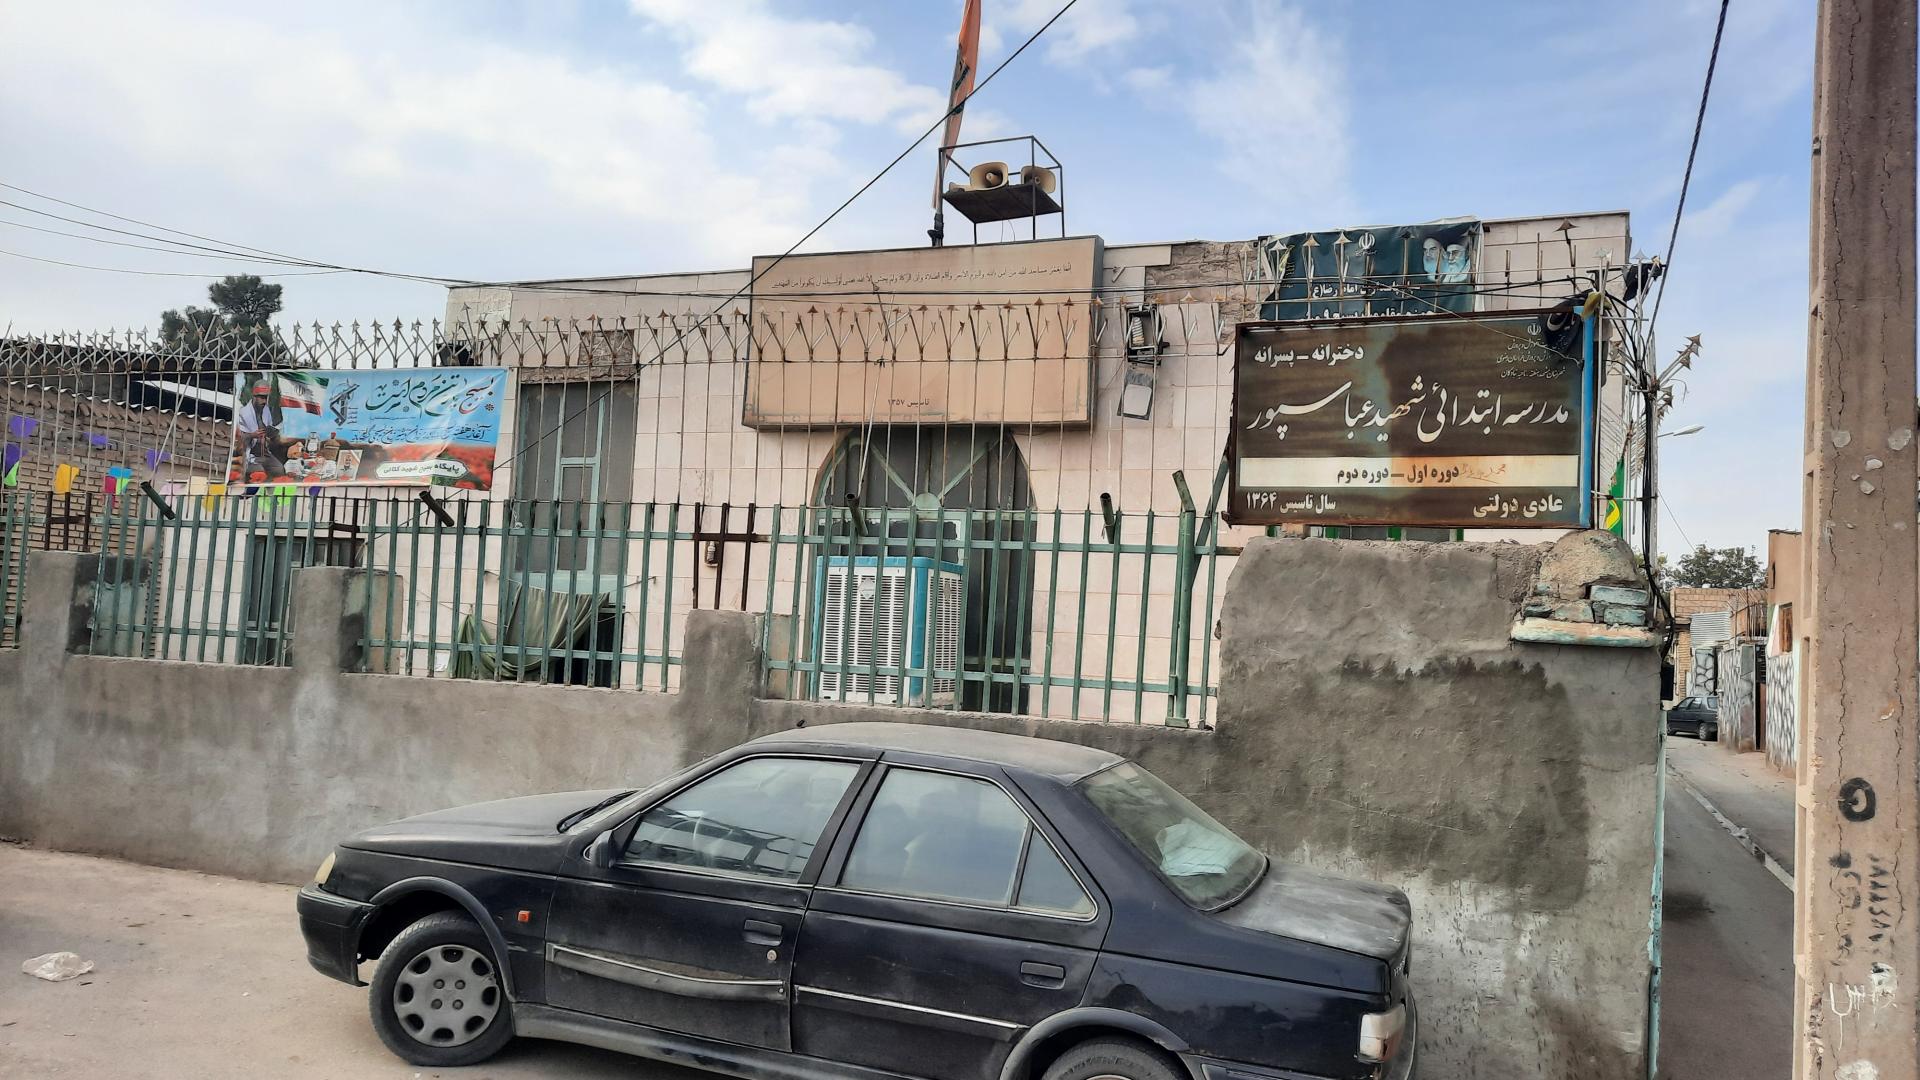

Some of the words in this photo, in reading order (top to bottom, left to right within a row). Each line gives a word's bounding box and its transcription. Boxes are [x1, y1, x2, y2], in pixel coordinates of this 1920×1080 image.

[1254, 345, 1295, 368] پسرانه
[1312, 343, 1365, 366] دخترانه
[408, 375, 442, 419] مردم
[1362, 375, 1427, 442] شهید
[1501, 401, 1569, 427] مدرسه
[433, 463, 460, 475] پایگاه
[1337, 467, 1359, 484] دوم
[1361, 466, 1389, 483] دوره
[1407, 463, 1428, 483] اول
[1431, 465, 1459, 484] دوره
[1246, 491, 1278, 511] ۱۳۶۴
[1280, 493, 1314, 514] تاسیس
[1315, 493, 1336, 514] سال
[1473, 493, 1519, 518] دولتی
[1523, 493, 1563, 518] عادی
